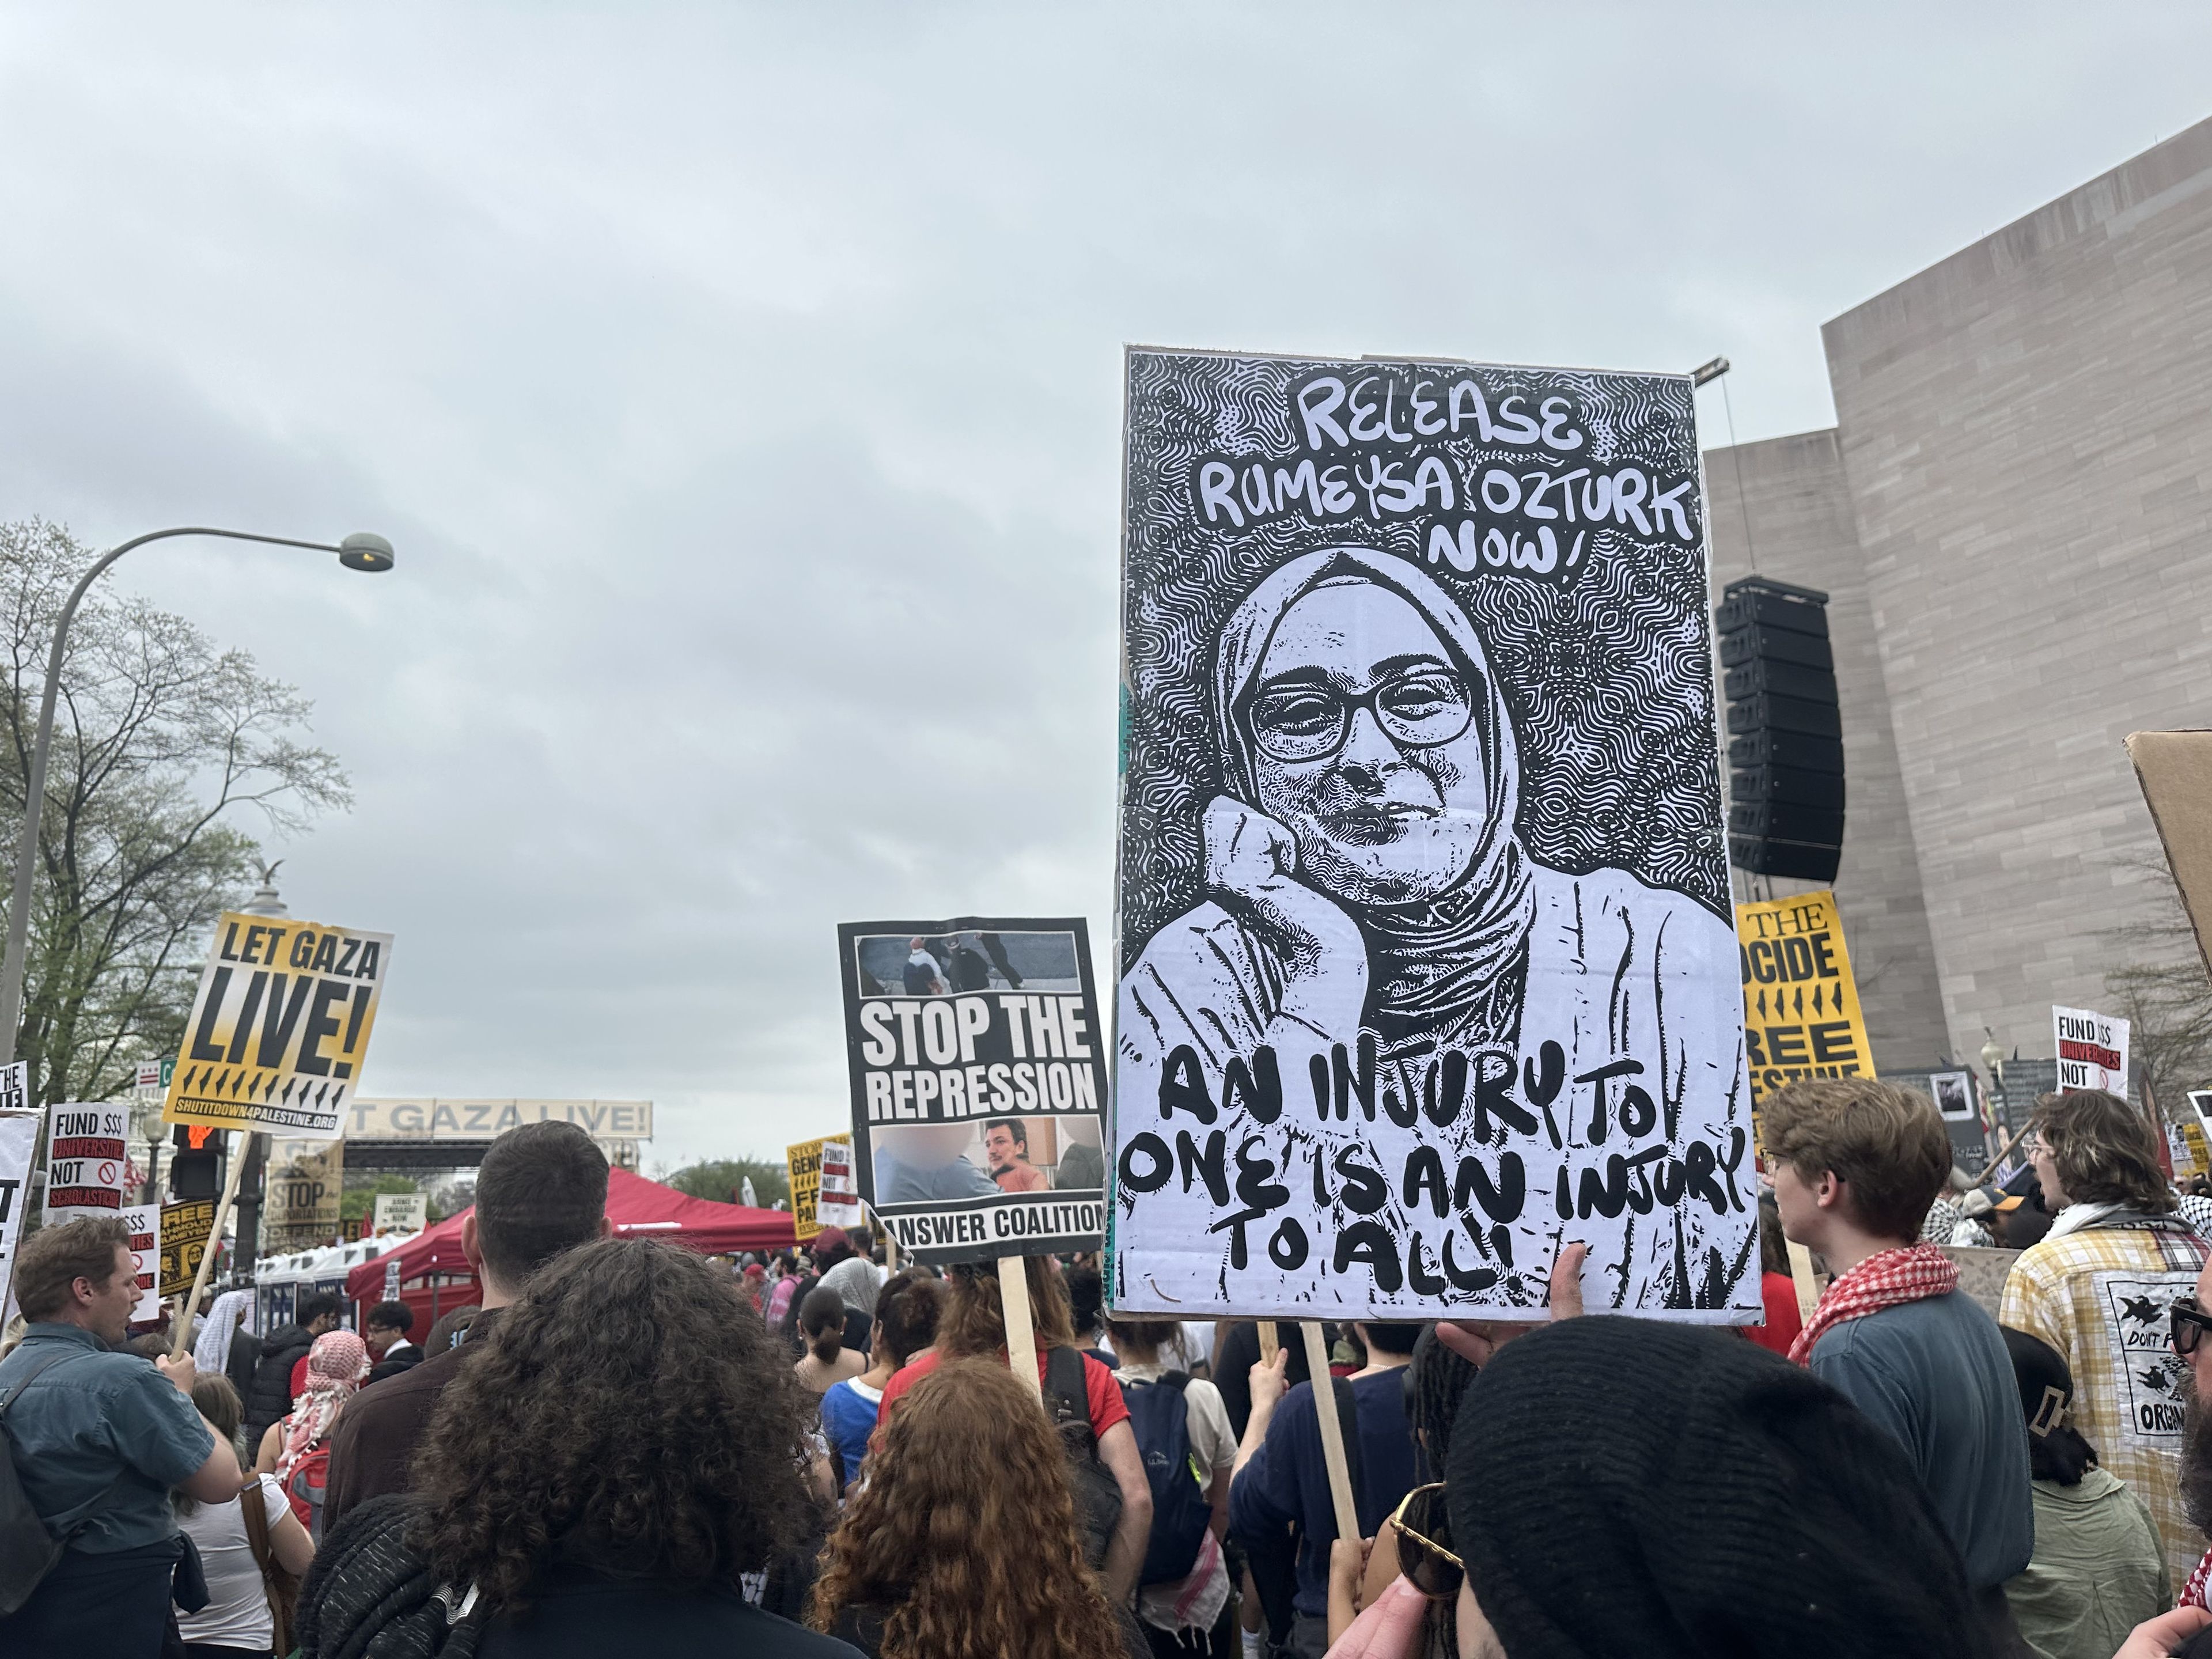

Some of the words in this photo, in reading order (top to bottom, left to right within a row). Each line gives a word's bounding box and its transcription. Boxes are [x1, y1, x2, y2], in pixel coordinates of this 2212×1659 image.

[1297, 377, 1584, 450] RELEASE
[1199, 456, 1453, 527] RUMEYSA
[1482, 468, 1694, 541] OZTURK
[1427, 519, 1585, 584] NOW!
[1746, 903, 1828, 938] THE
[220, 922, 286, 965] LET
[290, 930, 381, 980] GAZA
[190, 966, 373, 1080] LIVE!
[860, 997, 990, 1066] STOP
[1000, 996, 1092, 1058] THE
[2059, 1017, 2095, 1040] FUND
[865, 1062, 1099, 1120] REPRESSION
[1159, 1044, 1282, 1125] AN
[1309, 1037, 1563, 1150] INJURY
[1574, 1060, 1657, 1147] TO
[2061, 1061, 2088, 1086] NOT
[55, 1113, 99, 1136] FUND
[104, 1113, 122, 1137] $$$
[176, 1097, 338, 1130] SHUTITDOWN4PALESTINE.ORG
[389, 1104, 525, 1131] GAZA
[51, 1161, 84, 1185] NOT
[272, 1182, 325, 1209] STOP
[1119, 1130, 1289, 1212] ONE
[1313, 1143, 1387, 1214] IS
[1404, 1145, 1525, 1224] AN
[1558, 1127, 1745, 1220] INJURY
[995, 1203, 1103, 1238] COALITION
[1210, 1207, 1309, 1271] TO
[1333, 1220, 1522, 1296] ALL!
[2128, 1331, 2160, 1347] DON'T
